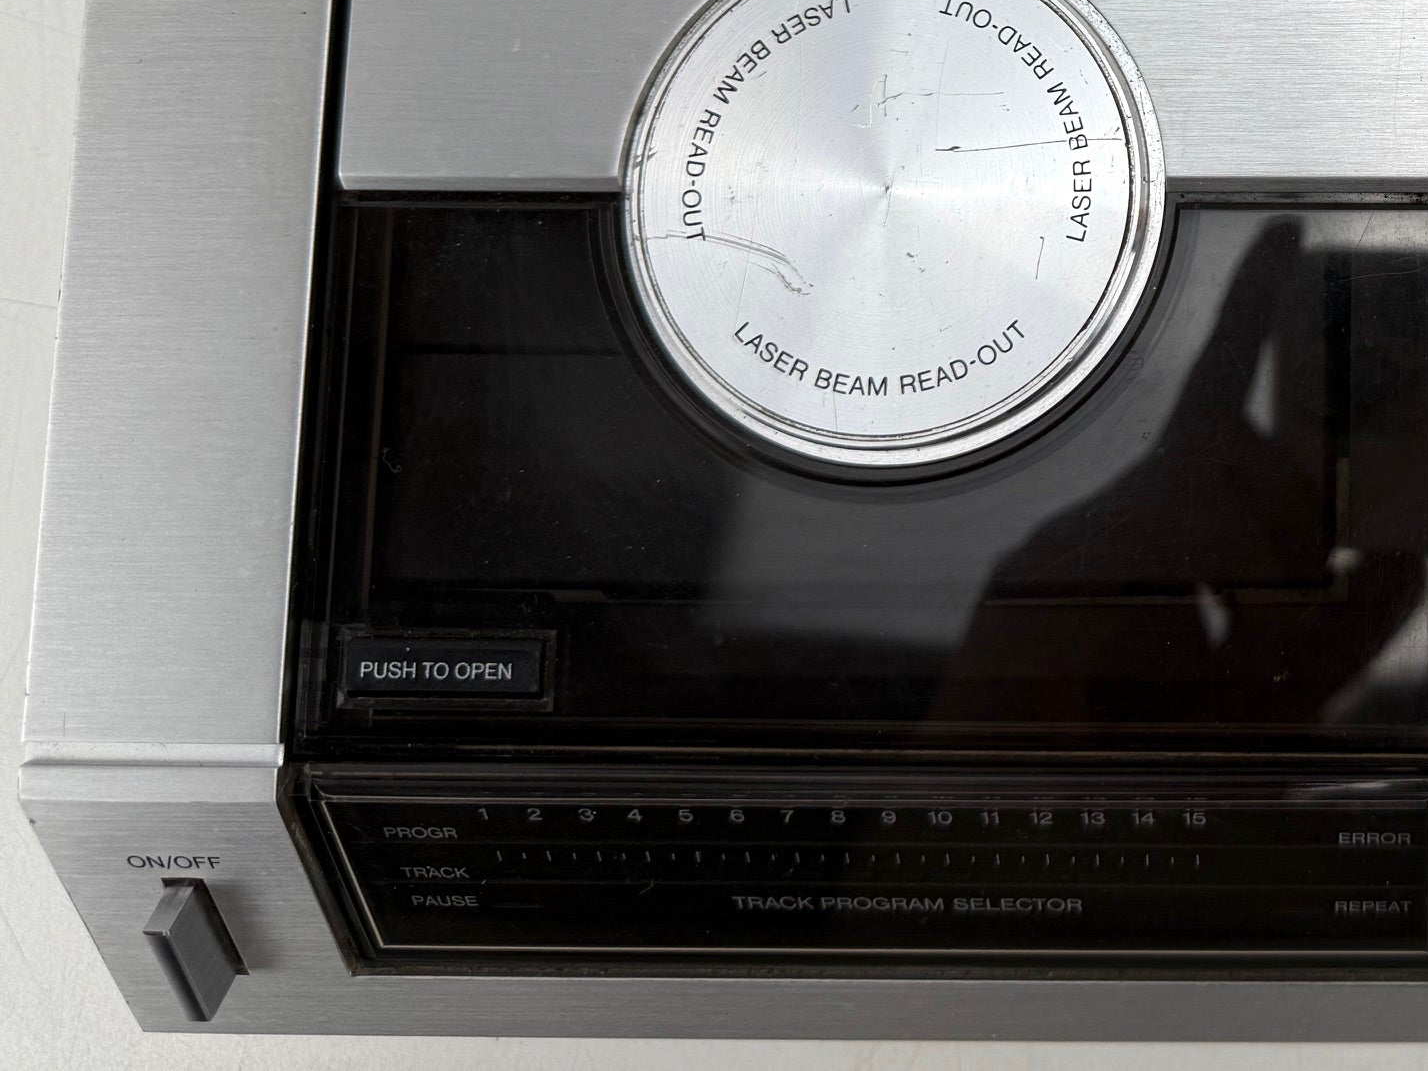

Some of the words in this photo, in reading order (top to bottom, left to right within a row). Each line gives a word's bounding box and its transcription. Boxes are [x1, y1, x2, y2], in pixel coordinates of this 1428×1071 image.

[712, 41, 770, 105] BEAM
[1046, 81, 1089, 151] BEAM
[682, 109, 722, 242] READ-OUT
[1066, 160, 1092, 243] LASER
[734, 321, 809, 382] LASER
[814, 368, 889, 397] BEAM
[900, 319, 1027, 395] READ-OUT
[360, 661, 416, 680] PUSH
[423, 662, 449, 680] TO
[455, 662, 513, 680] OPEN
[478, 808, 488, 820] 1
[528, 808, 543, 821] 2
[579, 808, 594, 822] 3
[627, 808, 643, 822] 4
[679, 809, 694, 823] 5
[730, 809, 745, 823] 6
[780, 809, 795, 823] 7
[831, 810, 846, 824] 8
[881, 810, 896, 824] 9
[928, 810, 952, 825] 10
[981, 810, 1000, 825] 11
[1030, 810, 1053, 825] 12
[1081, 810, 1105, 825] 13
[1132, 810, 1156, 825] 14
[1183, 811, 1206, 826] 15
[383, 827, 458, 839] PROGR
[1338, 832, 1411, 844] ERROR
[127, 855, 221, 870] ON/OFF
[401, 867, 469, 878] TRACK
[412, 895, 479, 907] PAUSE
[732, 896, 814, 910] TRACK
[821, 896, 945, 911] PROGRAM
[954, 897, 1083, 912] SELECTOR
[1335, 901, 1411, 913] REPEAT
